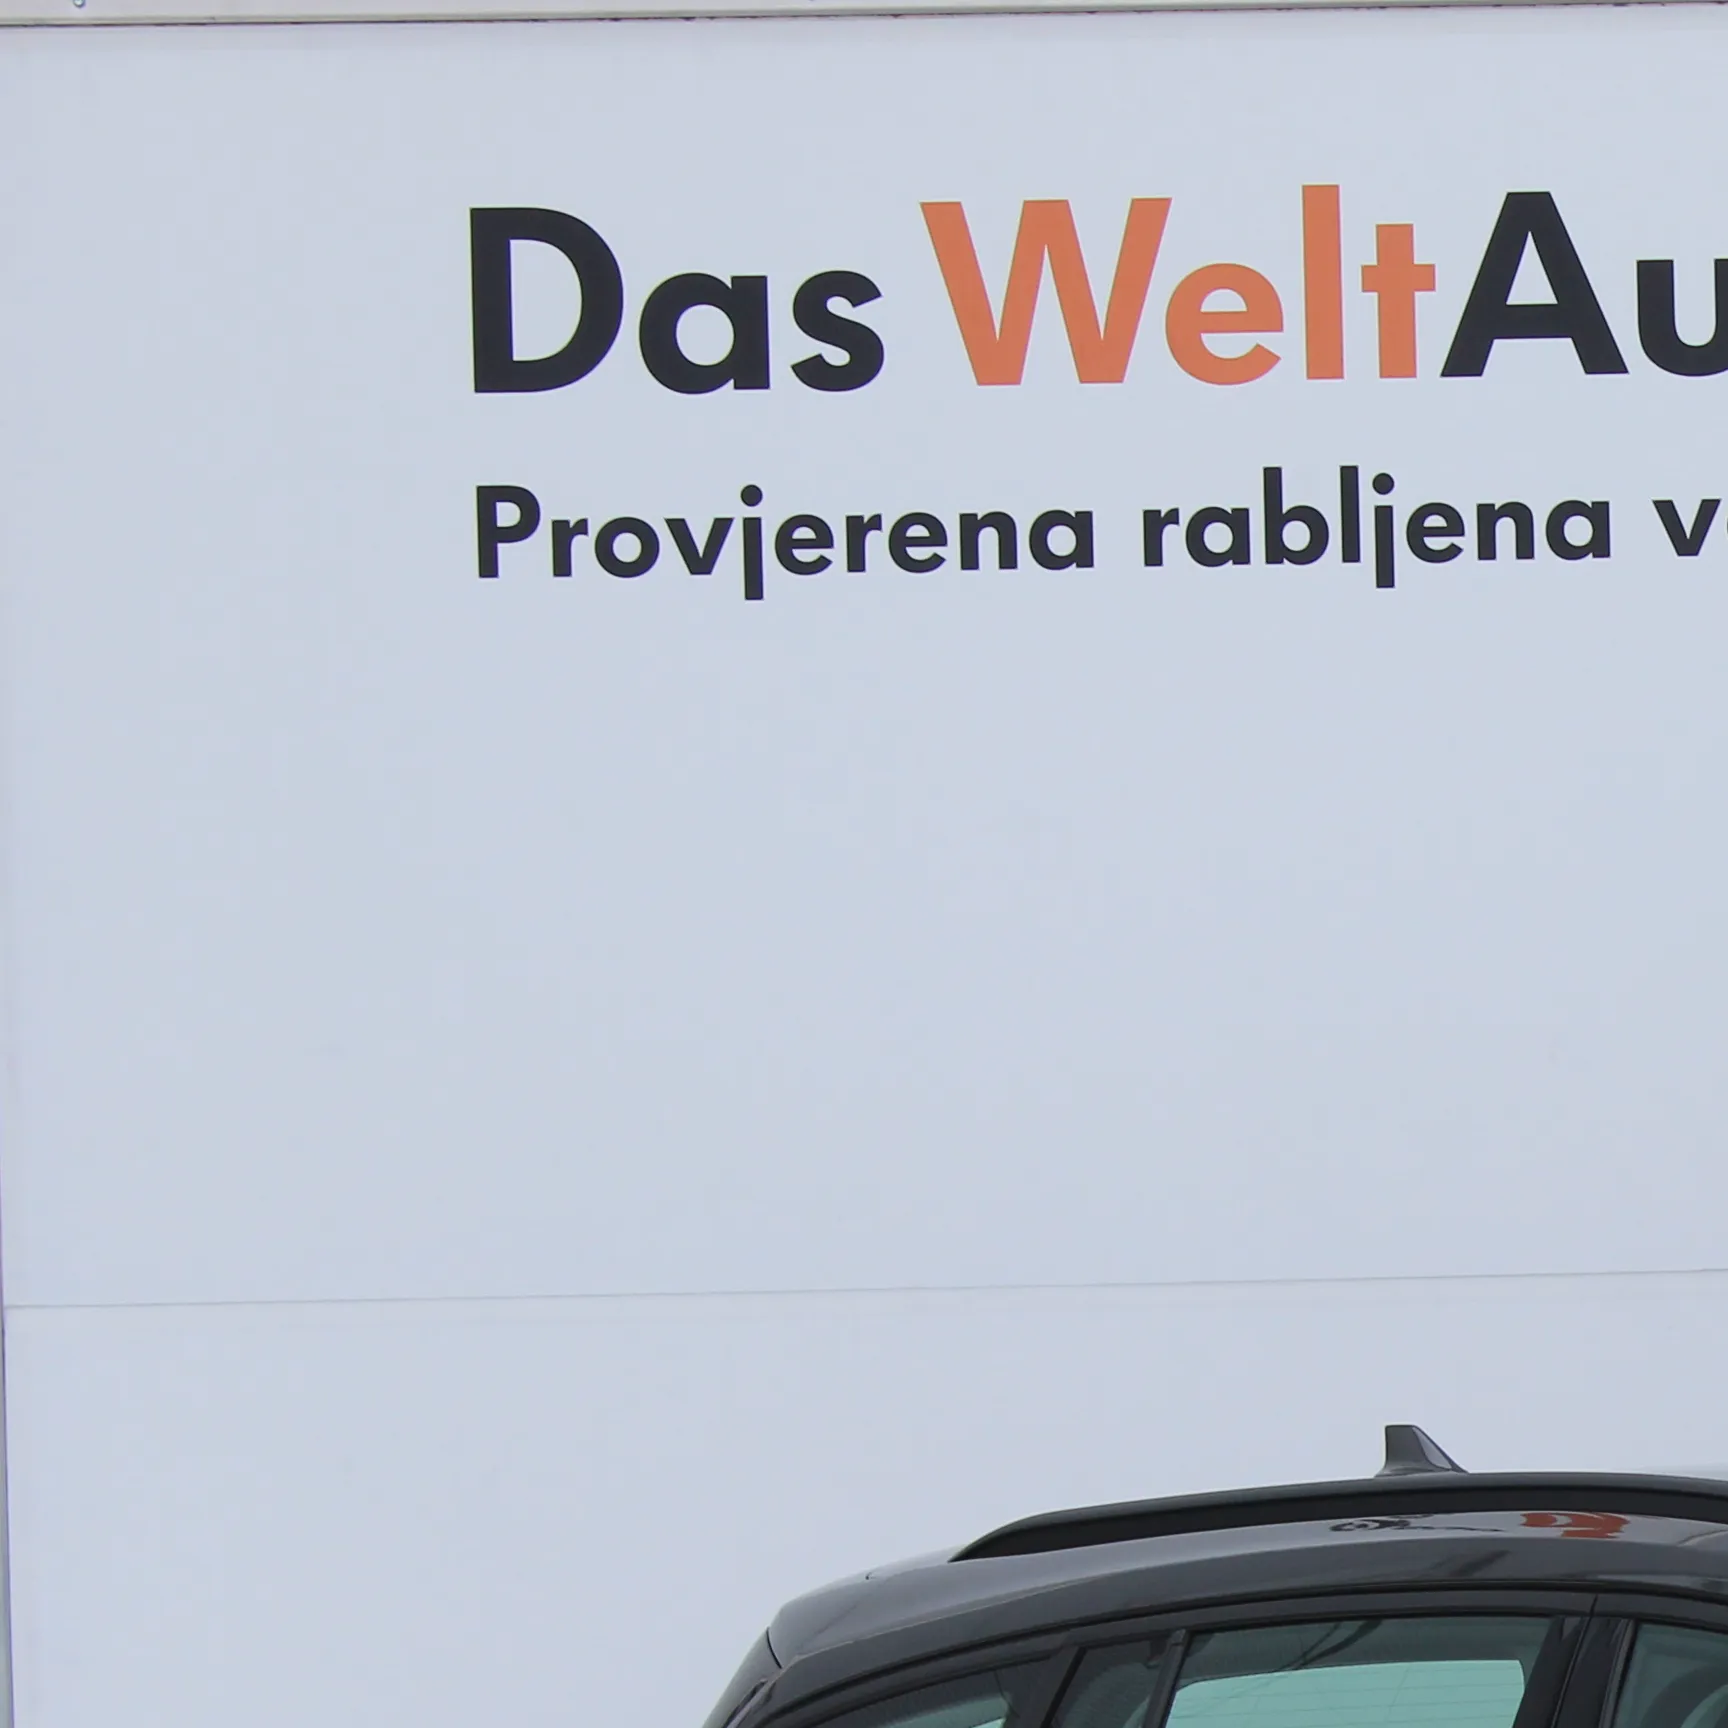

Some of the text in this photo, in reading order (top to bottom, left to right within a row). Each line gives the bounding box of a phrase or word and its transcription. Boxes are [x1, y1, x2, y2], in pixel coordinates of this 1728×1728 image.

[470, 207, 884, 394] Das
[476, 485, 1094, 600] Provjerena
[1143, 466, 1610, 588] rabljena
